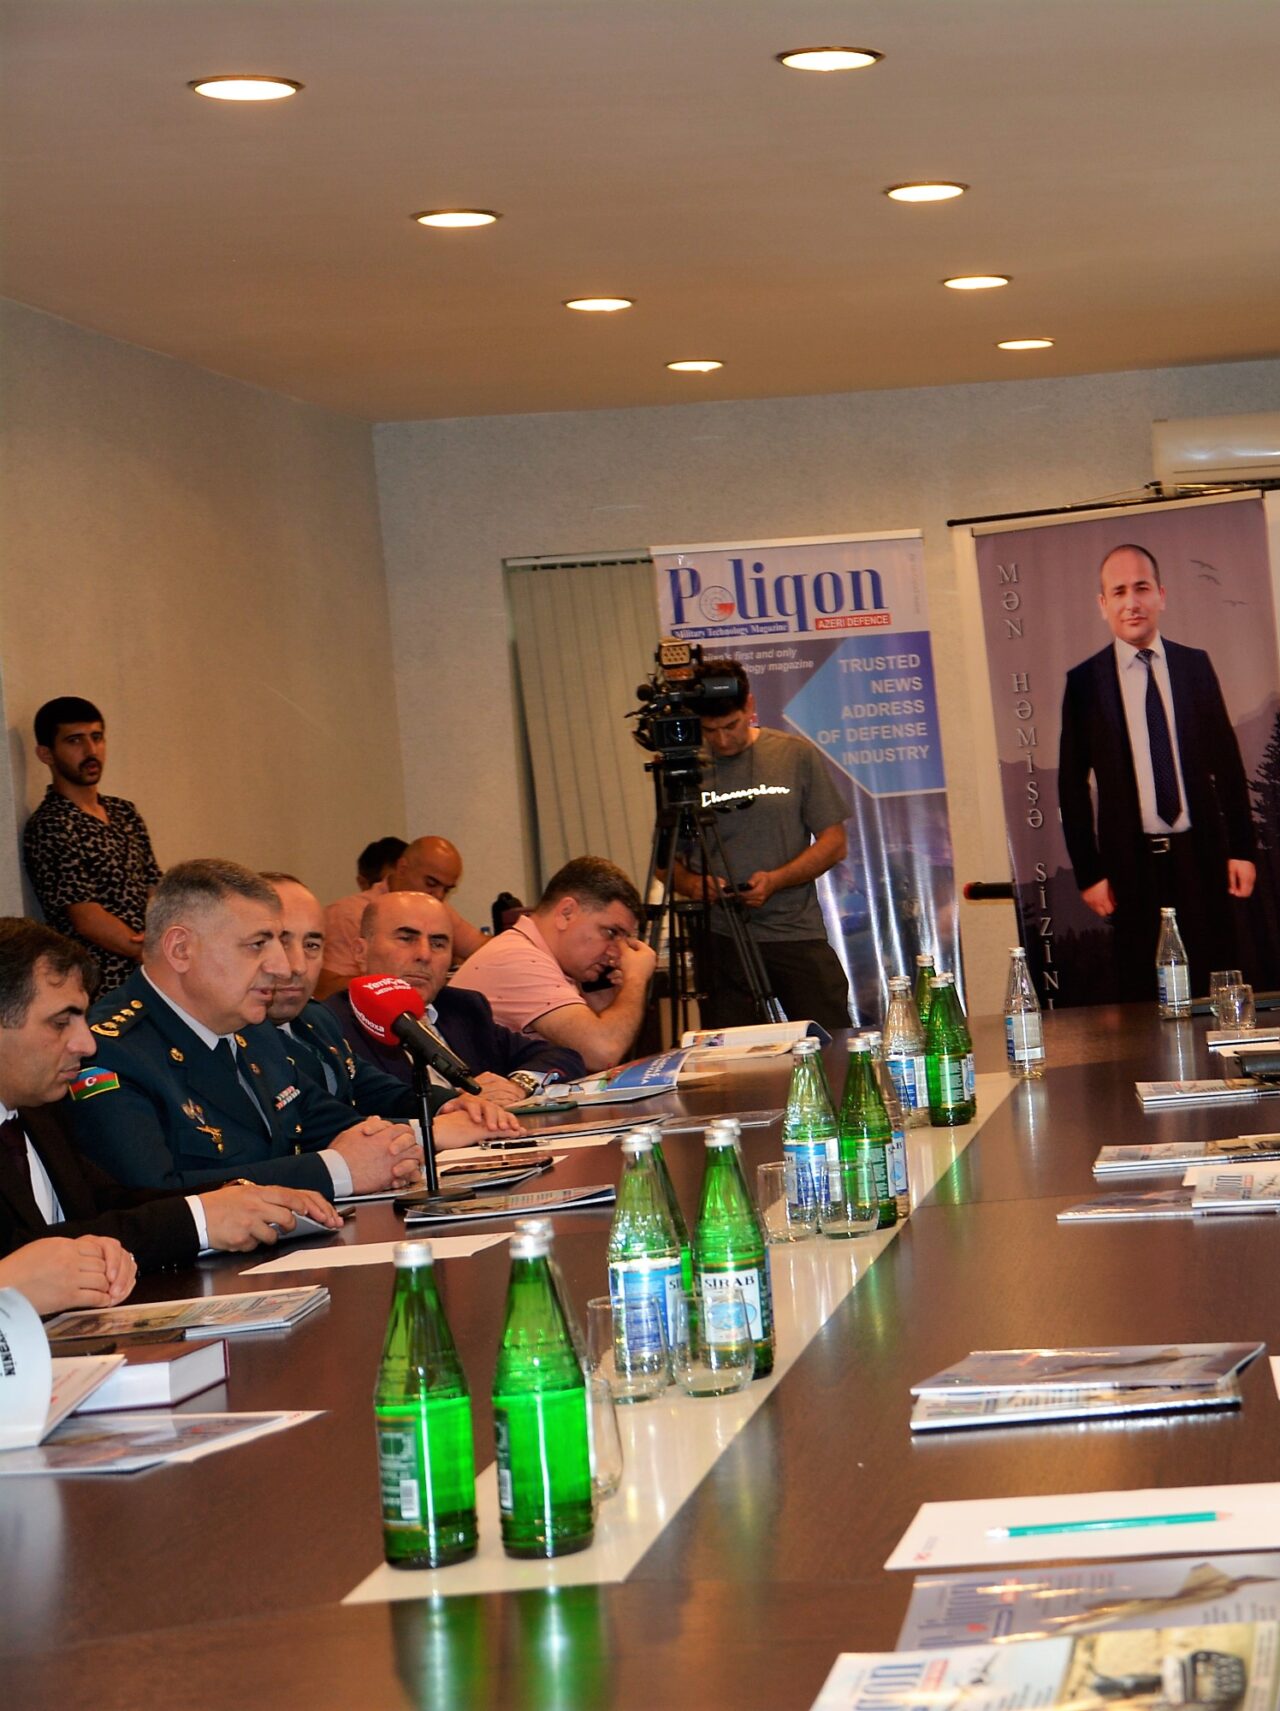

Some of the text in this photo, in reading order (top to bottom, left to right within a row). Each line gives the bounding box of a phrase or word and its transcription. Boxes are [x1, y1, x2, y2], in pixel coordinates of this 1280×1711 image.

[665, 558, 889, 632] Poliqon
[997, 563, 1023, 638] MƏN
[675, 623, 787, 639] Military Technology Magazine
[818, 614, 889, 630] AZERI DEFENCE
[734, 650, 753, 660] first
[756, 648, 774, 659] and
[776, 647, 798, 660] only
[838, 653, 921, 673] TRUSTED
[769, 659, 814, 673] magazine
[870, 676, 923, 694] NEWS
[841, 699, 926, 719] ADDRESS
[817, 721, 929, 744] OF DEFENSE
[842, 744, 931, 766] INDUSTRY
[701, 784, 790, 807] Champion
